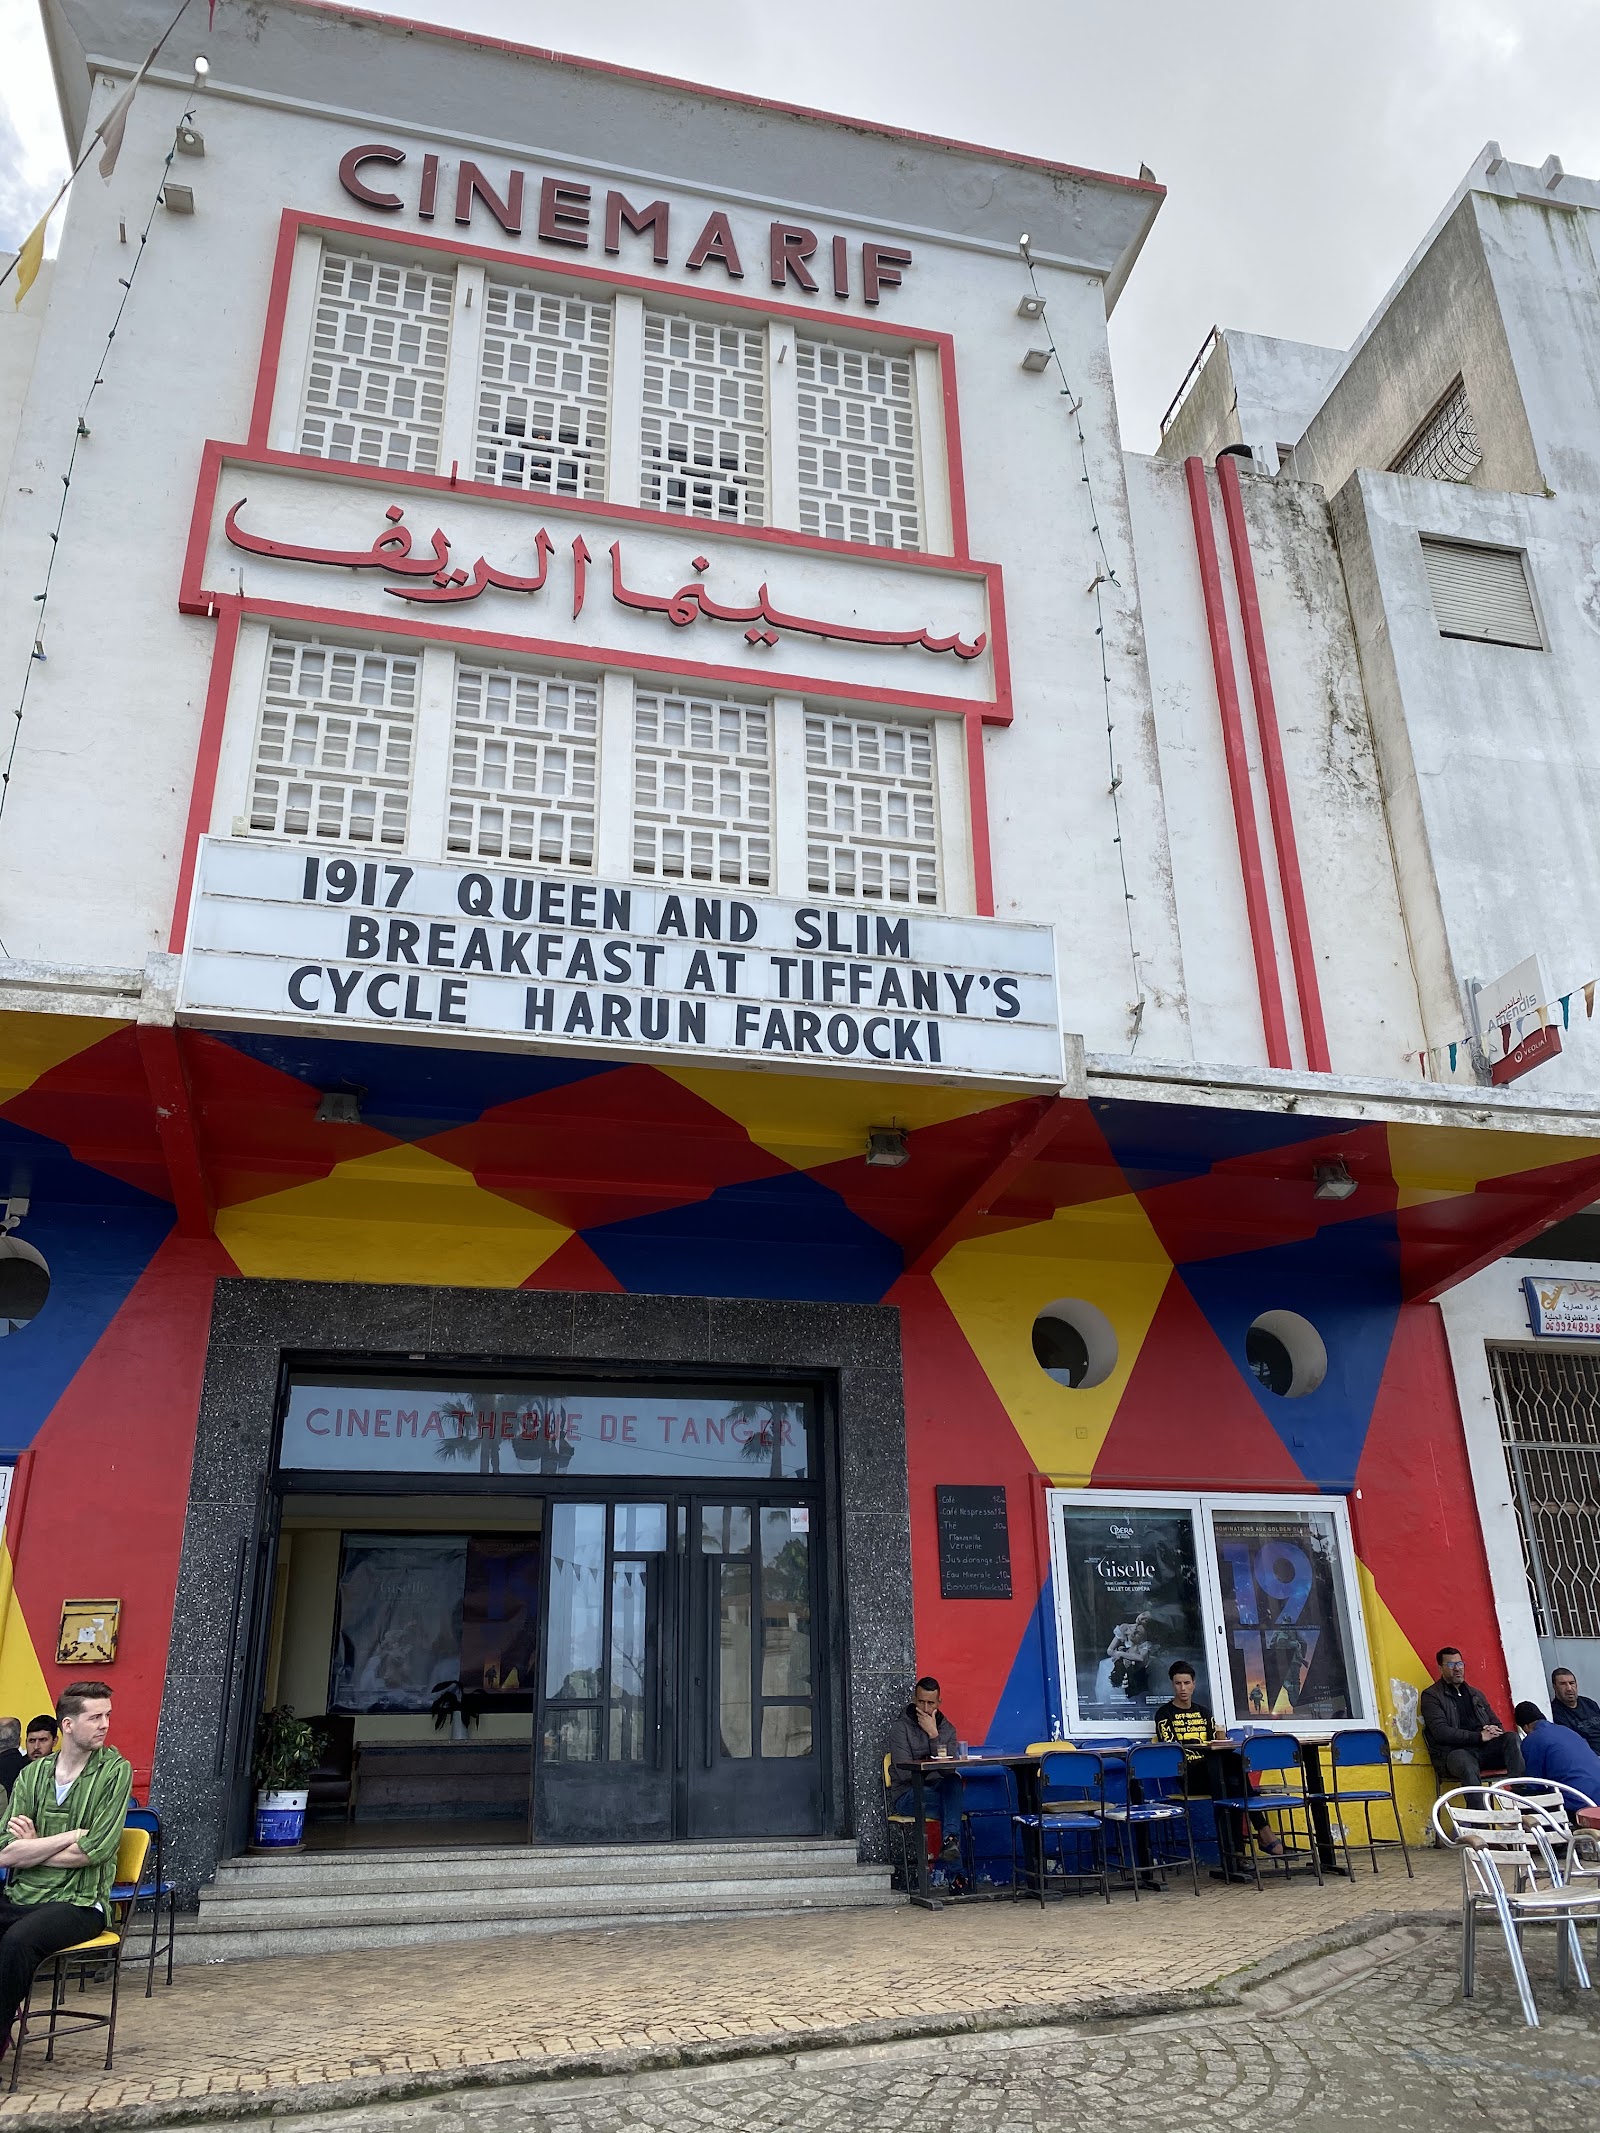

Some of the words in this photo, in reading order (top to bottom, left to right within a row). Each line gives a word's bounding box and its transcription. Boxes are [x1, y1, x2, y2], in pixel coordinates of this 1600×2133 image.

[339, 145, 745, 279] CINEMA
[771, 222, 913, 306] RIF
[225, 499, 592, 620] الريف
[609, 538, 987, 660] سينما
[303, 856, 414, 908] 1917
[458, 873, 632, 932] QUEEN
[656, 894, 758, 943] AND
[794, 908, 910, 959] SLIM
[346, 915, 665, 987] BREAKFAST
[684, 949, 746, 994] AT
[770, 956, 1021, 1019] TIFFANY'S
[287, 965, 468, 1024] CYCLE
[524, 986, 706, 1044] HARUN
[735, 1004, 942, 1063] FAROCKI
[1488, 993, 1537, 1032] Amendis
[1523, 1040, 1545, 1056] VEOLIA
[306, 1407, 583, 1441] CINEMATHEQUE
[600, 1414, 638, 1443] DE
[657, 1415, 796, 1447] TANGER
[942, 1496, 955, 1504] Café
[942, 1507, 957, 1515] Café
[944, 1521, 957, 1529] Thé
[945, 1554, 960, 1563] Jus
[962, 1554, 993, 1566] d'orange
[950, 1542, 982, 1550] Verveine
[1096, 1556, 1156, 1578] Giselle
